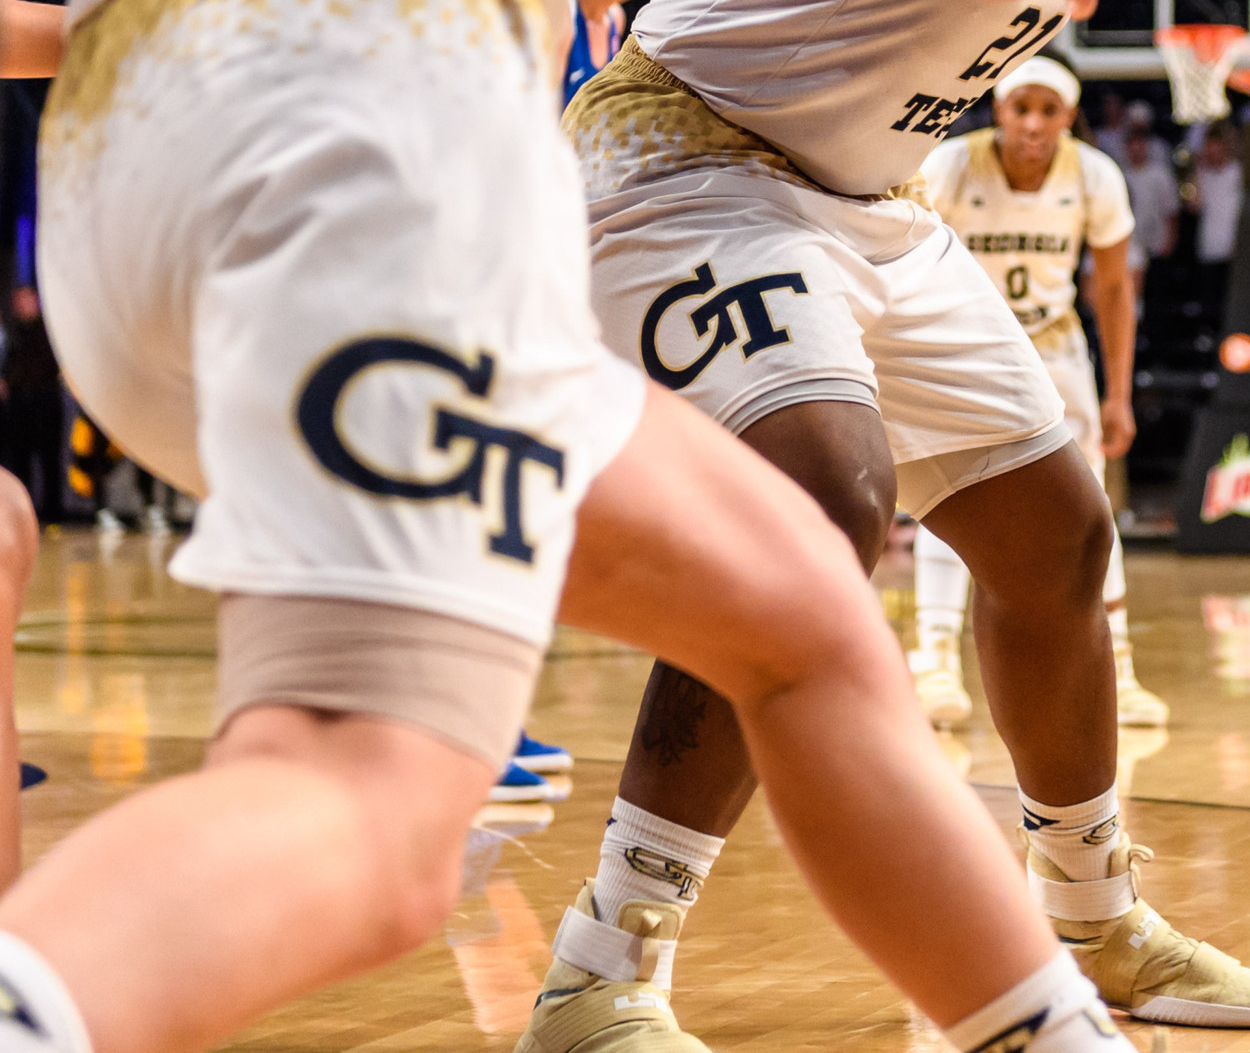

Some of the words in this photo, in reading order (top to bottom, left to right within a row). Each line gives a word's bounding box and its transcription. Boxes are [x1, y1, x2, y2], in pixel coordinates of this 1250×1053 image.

[957, 6, 1064, 82] 21
[640, 260, 809, 391] GT
[1006, 265, 1028, 299] 0
[291, 332, 568, 569] GT
